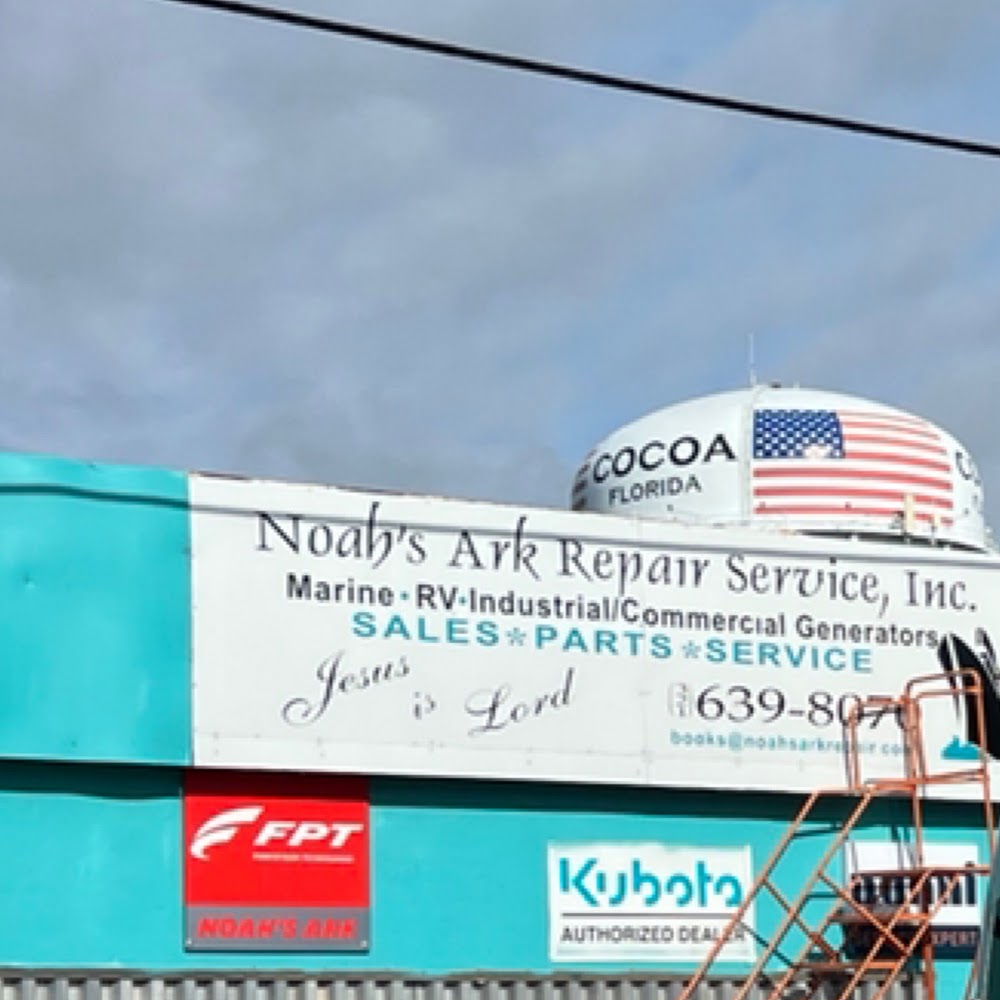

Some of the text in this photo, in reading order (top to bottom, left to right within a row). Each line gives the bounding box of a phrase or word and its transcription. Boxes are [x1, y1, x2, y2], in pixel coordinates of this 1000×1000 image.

[592, 433, 736, 484] COCOA
[608, 474, 702, 506] FLORIDA
[257, 501, 978, 618] Noah's Ark Repair Service, Inc.
[286, 572, 938, 649] Marine RV Industrial/Commercial Generators
[352, 611, 874, 674] SALES PARTS SERVICE
[281, 650, 410, 727] Jesus
[464, 667, 576, 735] Lord
[253, 820, 364, 848] FPT
[559, 857, 742, 908] Kubota
[196, 914, 358, 939] NOAH'S ARK
[561, 924, 744, 943] AUTHORIZED DEALR
